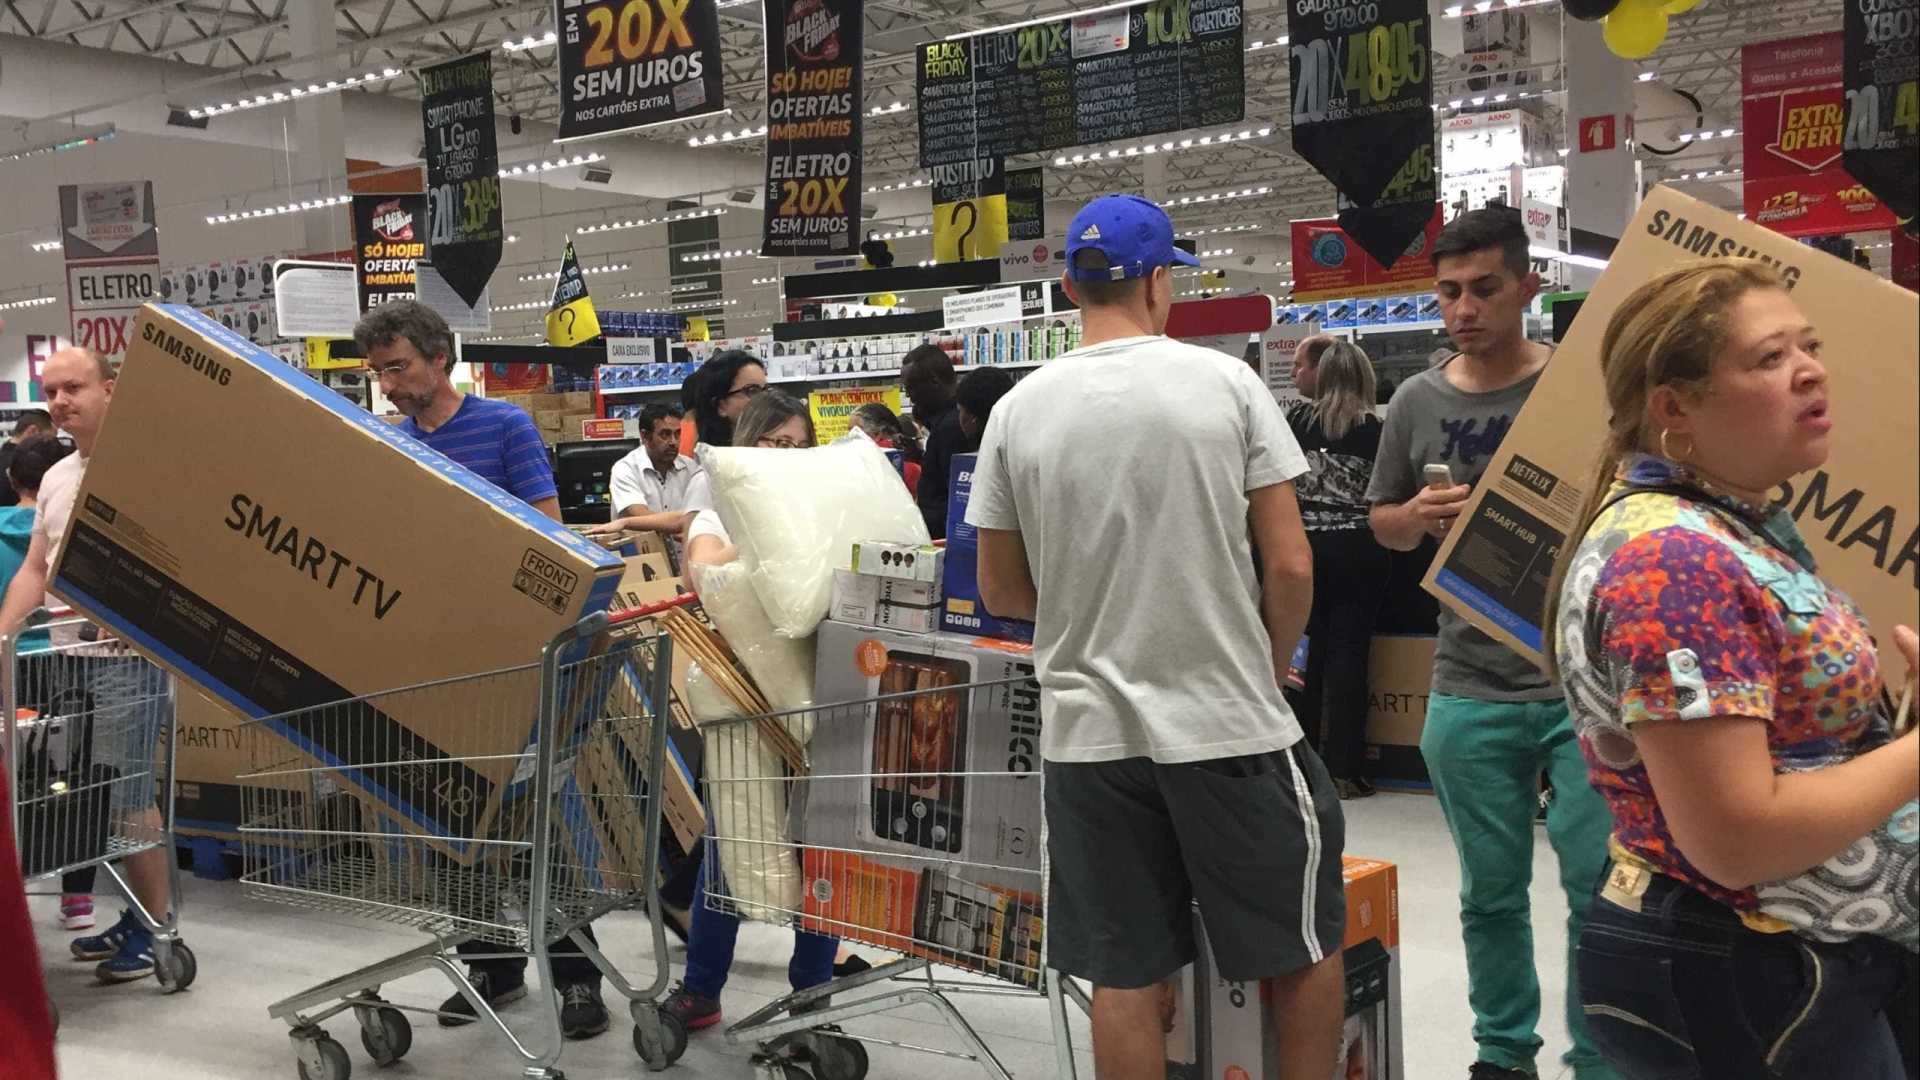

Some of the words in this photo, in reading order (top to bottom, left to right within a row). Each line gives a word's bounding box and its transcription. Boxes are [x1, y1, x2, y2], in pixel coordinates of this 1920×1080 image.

[565, 13, 579, 44] EM
[585, 0, 694, 67] 20X
[926, 41, 965, 62] BLACK
[1472, 52, 1499, 63] ARNO
[573, 67, 622, 101] SEM
[627, 51, 703, 96] JUROS
[771, 66, 797, 93] SÓ
[800, 66, 852, 94] HOJE!
[925, 57, 969, 79] FRIDAY
[427, 96, 486, 129] SMARTPHONE
[575, 108, 595, 122] NOS
[596, 100, 637, 119] CARTÕES
[639, 94, 670, 110] EXTRA
[769, 93, 852, 119] OFERTAS
[1487, 112, 1511, 123] ARNO
[439, 122, 465, 153] LG
[770, 116, 852, 140] IMBATÍVEIS
[770, 153, 851, 178] ELETRO
[770, 182, 778, 200] EM
[779, 177, 849, 216] 20X
[770, 218, 801, 234] SEM
[803, 216, 848, 236] JUROS
[364, 241, 383, 257] SÓ
[385, 243, 425, 258] HOJE!
[1003, 252, 1030, 265] vivo
[79, 273, 153, 301] ELETRO
[141, 321, 232, 387] SAMSUNG
[1266, 339, 1296, 350] extra
[1510, 460, 1552, 493] NETFLIX
[1483, 507, 1516, 533] SMART
[1514, 525, 1538, 545] HUB
[224, 493, 351, 590] SMART
[351, 565, 402, 621] TV
[526, 554, 577, 591] FRONT
